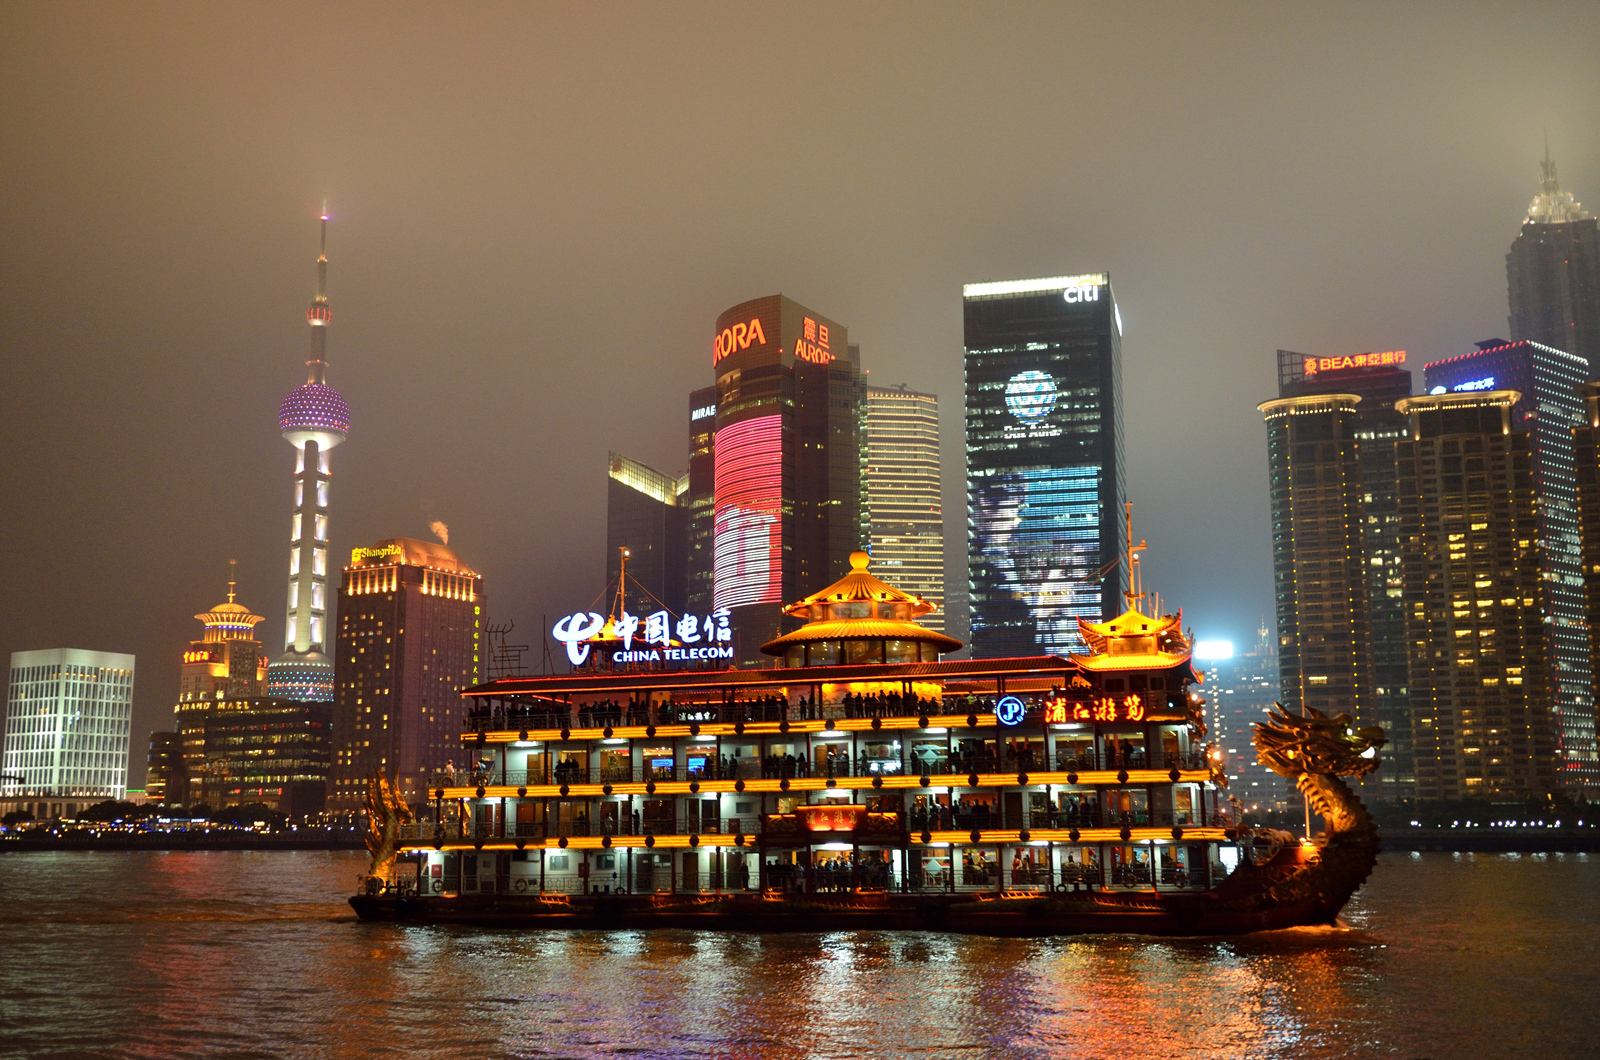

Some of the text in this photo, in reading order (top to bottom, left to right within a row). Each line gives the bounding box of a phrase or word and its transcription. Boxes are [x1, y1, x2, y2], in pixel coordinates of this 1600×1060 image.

[1063, 284, 1099, 303] citi
[803, 316, 830, 349] 震旦
[795, 338, 836, 364] AUROR
[1320, 356, 1354, 371] BEA
[691, 404, 717, 421] MIRAE
[613, 607, 732, 650] 中国电信
[613, 647, 733, 663] CHINA TELECOM
